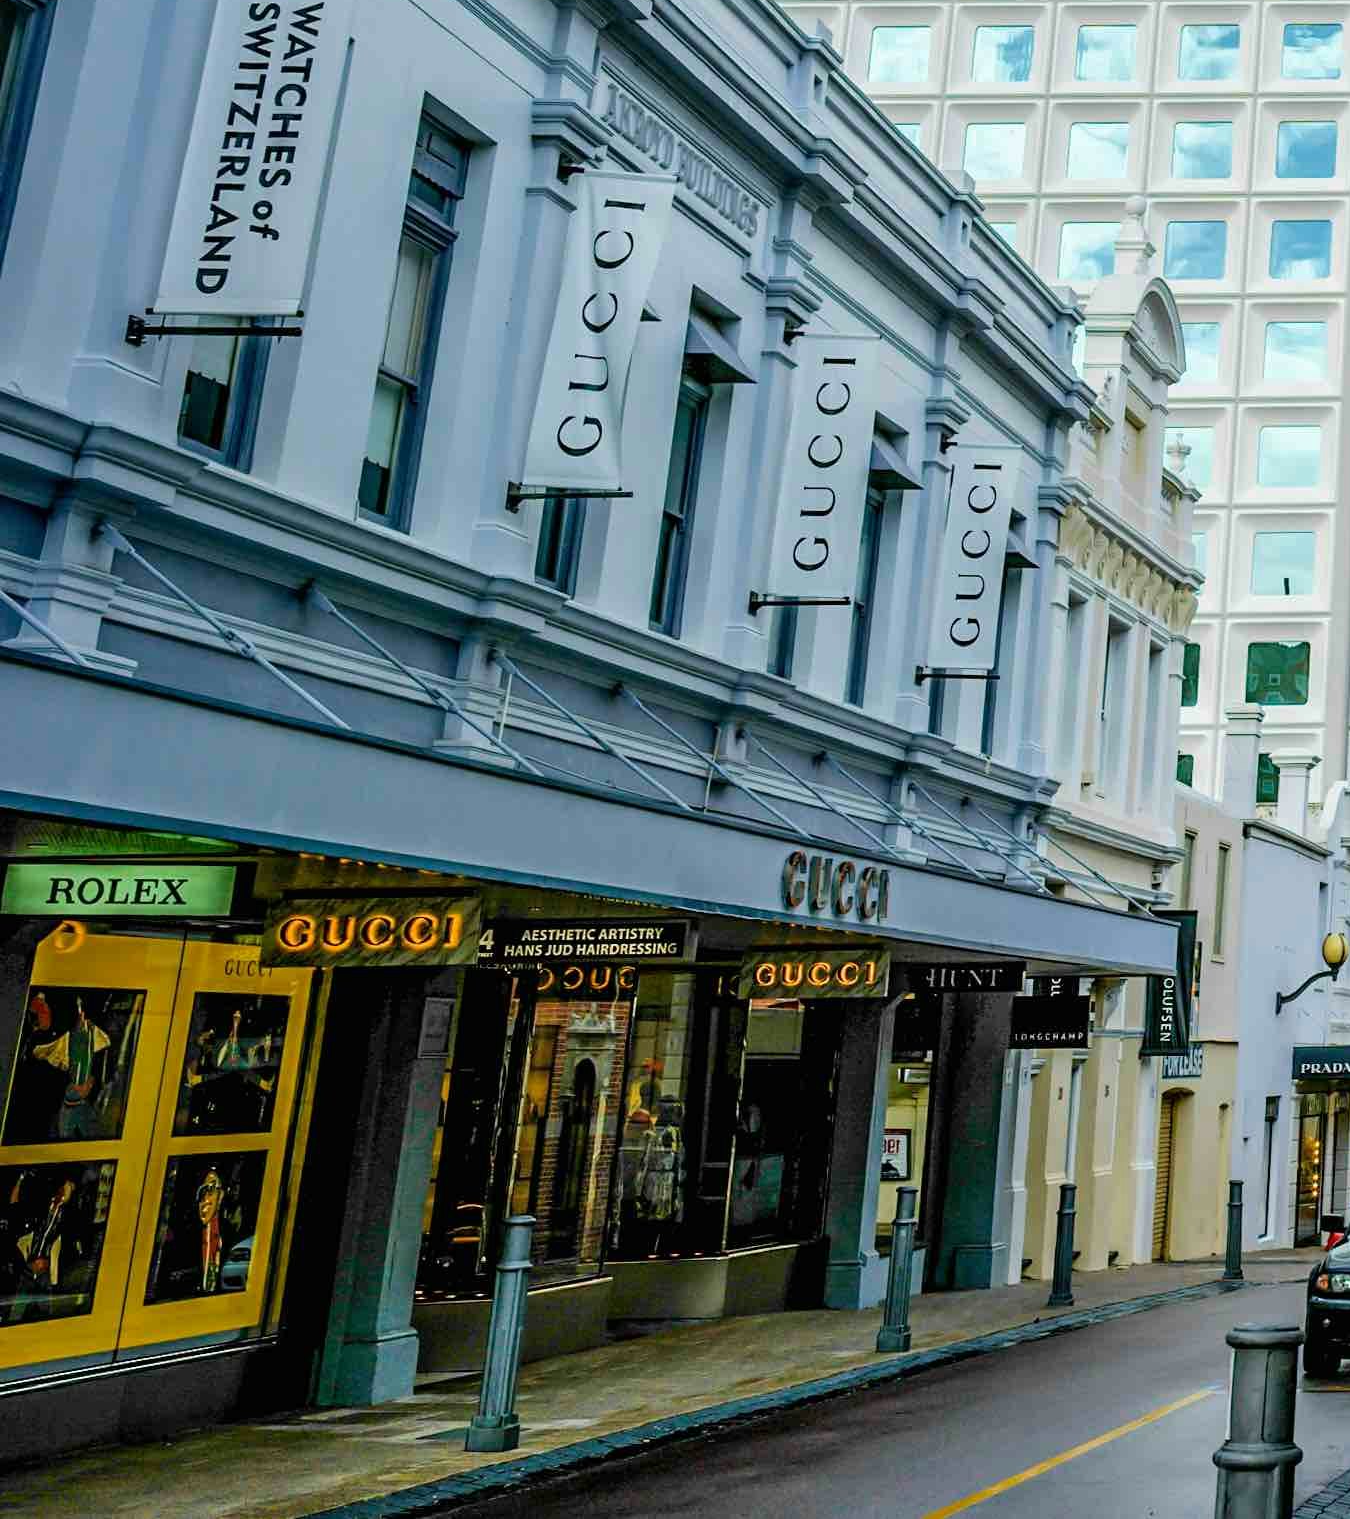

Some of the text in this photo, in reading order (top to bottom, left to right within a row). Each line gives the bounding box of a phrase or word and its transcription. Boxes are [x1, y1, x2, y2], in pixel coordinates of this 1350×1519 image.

[195, 2, 280, 295] SWITZERLAND
[249, 1, 325, 242] WATCHES of
[557, 198, 646, 457] GUCCI
[793, 356, 857, 572] GUCCI
[949, 463, 1002, 648] GUCCI
[46, 877, 188, 905] ROLEX
[781, 849, 890, 921] GUCCI
[279, 912, 464, 951] GUCCI
[504, 944, 542, 958] HANS
[544, 944, 573, 957] JUD
[576, 942, 678, 956] HAIRDRESSING
[521, 927, 664, 942] AESTHETIC ARTISTRY
[754, 960, 880, 988] GUCCI
[1014, 1032, 1084, 1042] LONGCHAMP
[1159, 977, 1175, 1043] OLUFSEN
